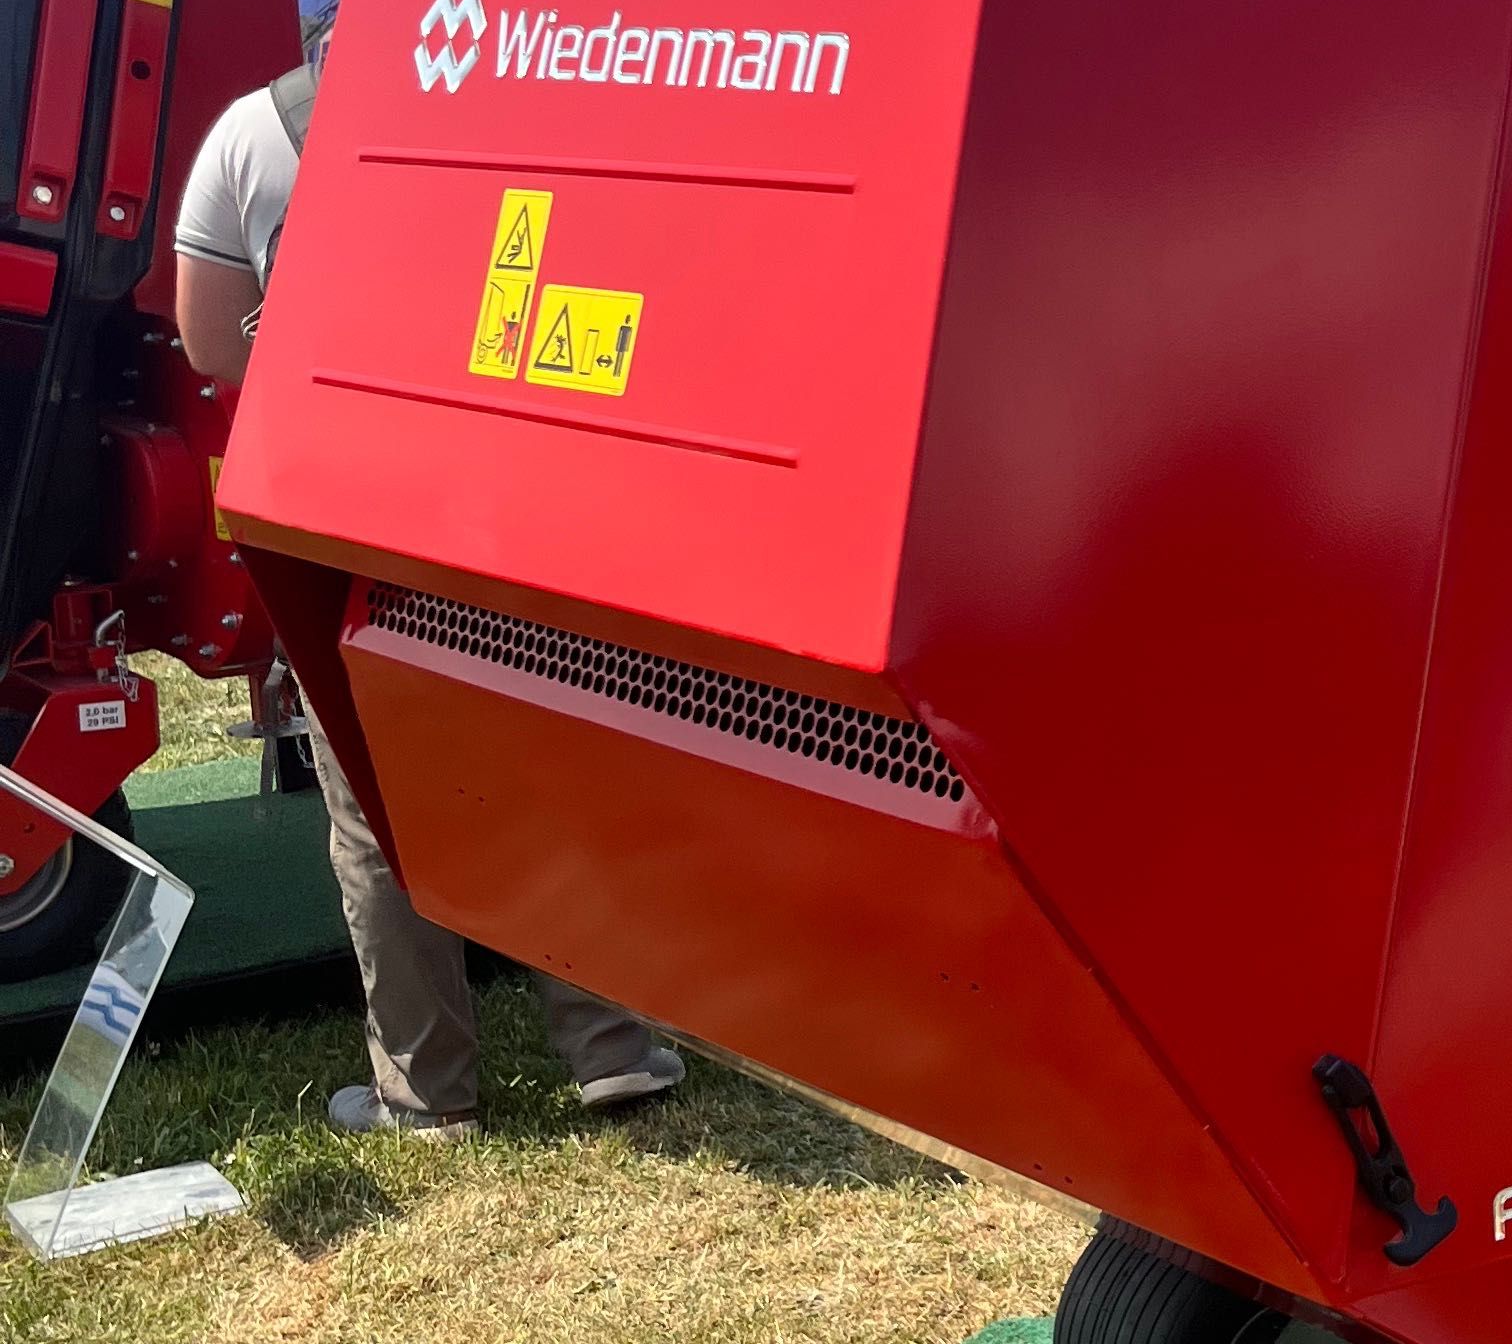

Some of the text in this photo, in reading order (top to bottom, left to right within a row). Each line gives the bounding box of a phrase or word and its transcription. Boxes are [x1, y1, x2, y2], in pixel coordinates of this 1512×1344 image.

[495, 8, 850, 96] Wiedenmann
[102, 706, 119, 715] bar
[102, 716, 119, 726] PSI
